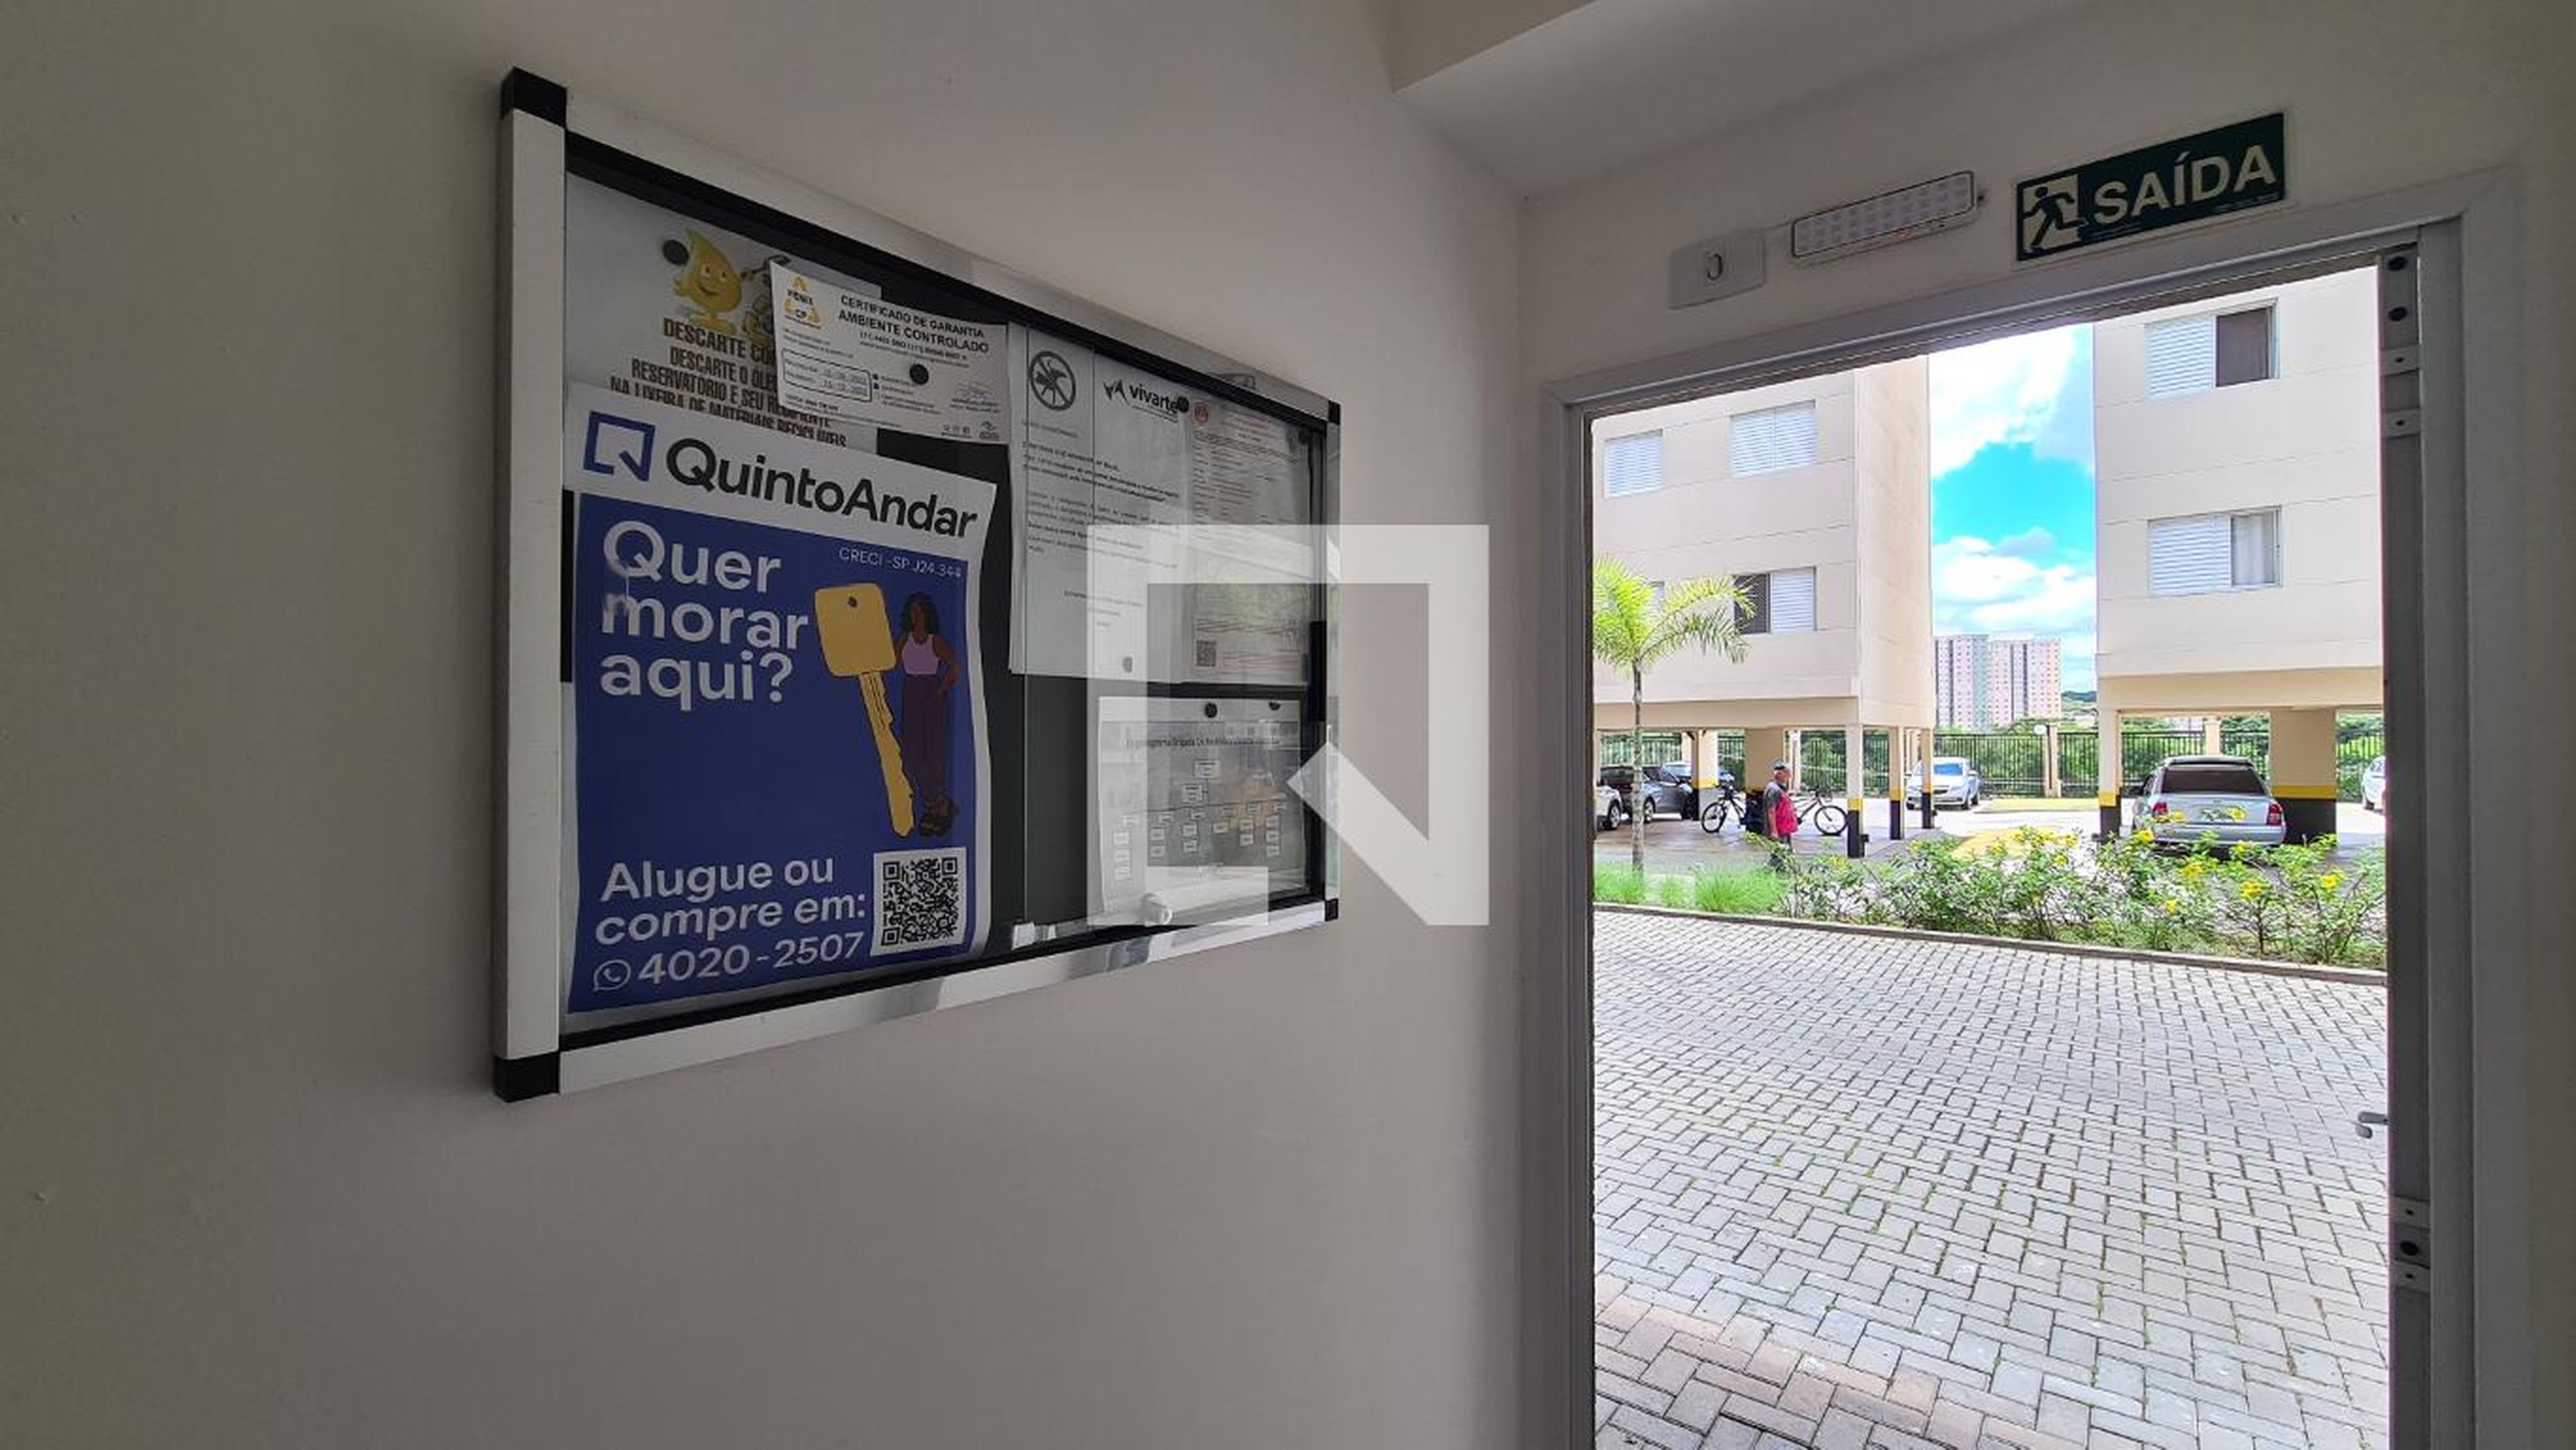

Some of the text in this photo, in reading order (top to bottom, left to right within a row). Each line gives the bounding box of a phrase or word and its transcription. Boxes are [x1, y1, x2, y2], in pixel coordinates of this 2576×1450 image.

[2094, 145, 2276, 225] SAÍDA
[663, 317, 747, 359] DESCARTE
[839, 309, 901, 335] AMBIENTE
[904, 327, 989, 354] CONTROLADO
[841, 295, 911, 323] CERTIFICADO
[913, 315, 927, 327] DE
[930, 320, 984, 339] GARANTIA
[670, 346, 737, 382] DESCARTE
[731, 384, 739, 406] E
[741, 387, 763, 411] SEU
[666, 437, 978, 537] QuintoAndar
[604, 521, 781, 592] Quer
[602, 590, 809, 650] morar
[600, 650, 793, 711] aqui?
[601, 858, 834, 903] Alugue ou
[595, 893, 865, 945] compre em:
